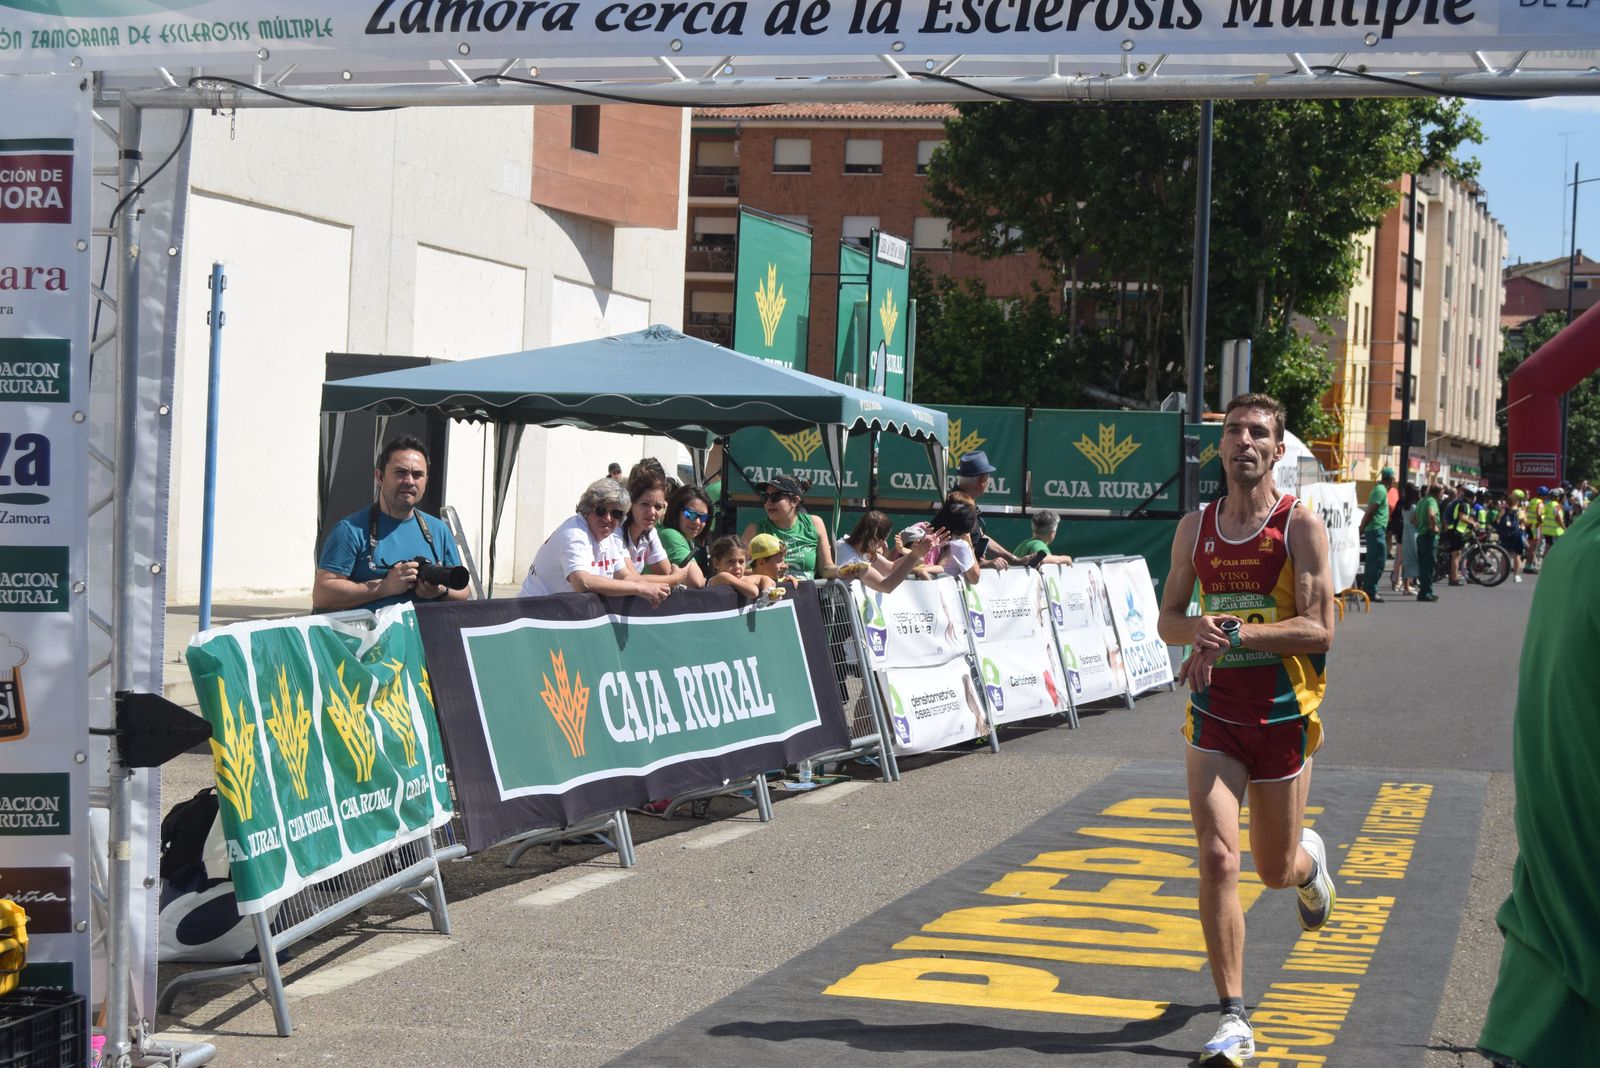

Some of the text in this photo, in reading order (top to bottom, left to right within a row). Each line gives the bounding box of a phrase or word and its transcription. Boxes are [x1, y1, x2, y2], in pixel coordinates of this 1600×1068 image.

[593, 0, 746, 37] cerca
[918, 0, 1202, 33] Esclerosis
[31, 25, 121, 49] ZAMORANA
[128, 24, 151, 46] DE
[159, 21, 250, 44] ESCLEROSIS
[258, 15, 334, 41] MÚLTIPLE
[40, 169, 63, 183] DE
[0, 186, 64, 209] ORA
[0, 362, 60, 379] ACION
[0, 379, 60, 394] RURAL
[890, 472, 938, 491] CAJA
[1043, 480, 1169, 500] CAJA RURAL
[0, 572, 60, 589] ACION
[1219, 571, 1250, 581] VINO
[1211, 580, 1260, 592] DE TORO
[1220, 600, 1265, 611] CAJA RURAL
[1225, 651, 1276, 662] CAJA RURAL
[598, 655, 776, 745] CAJA RURAL
[0, 796, 60, 812] ACION
[0, 813, 60, 828] RURAL
